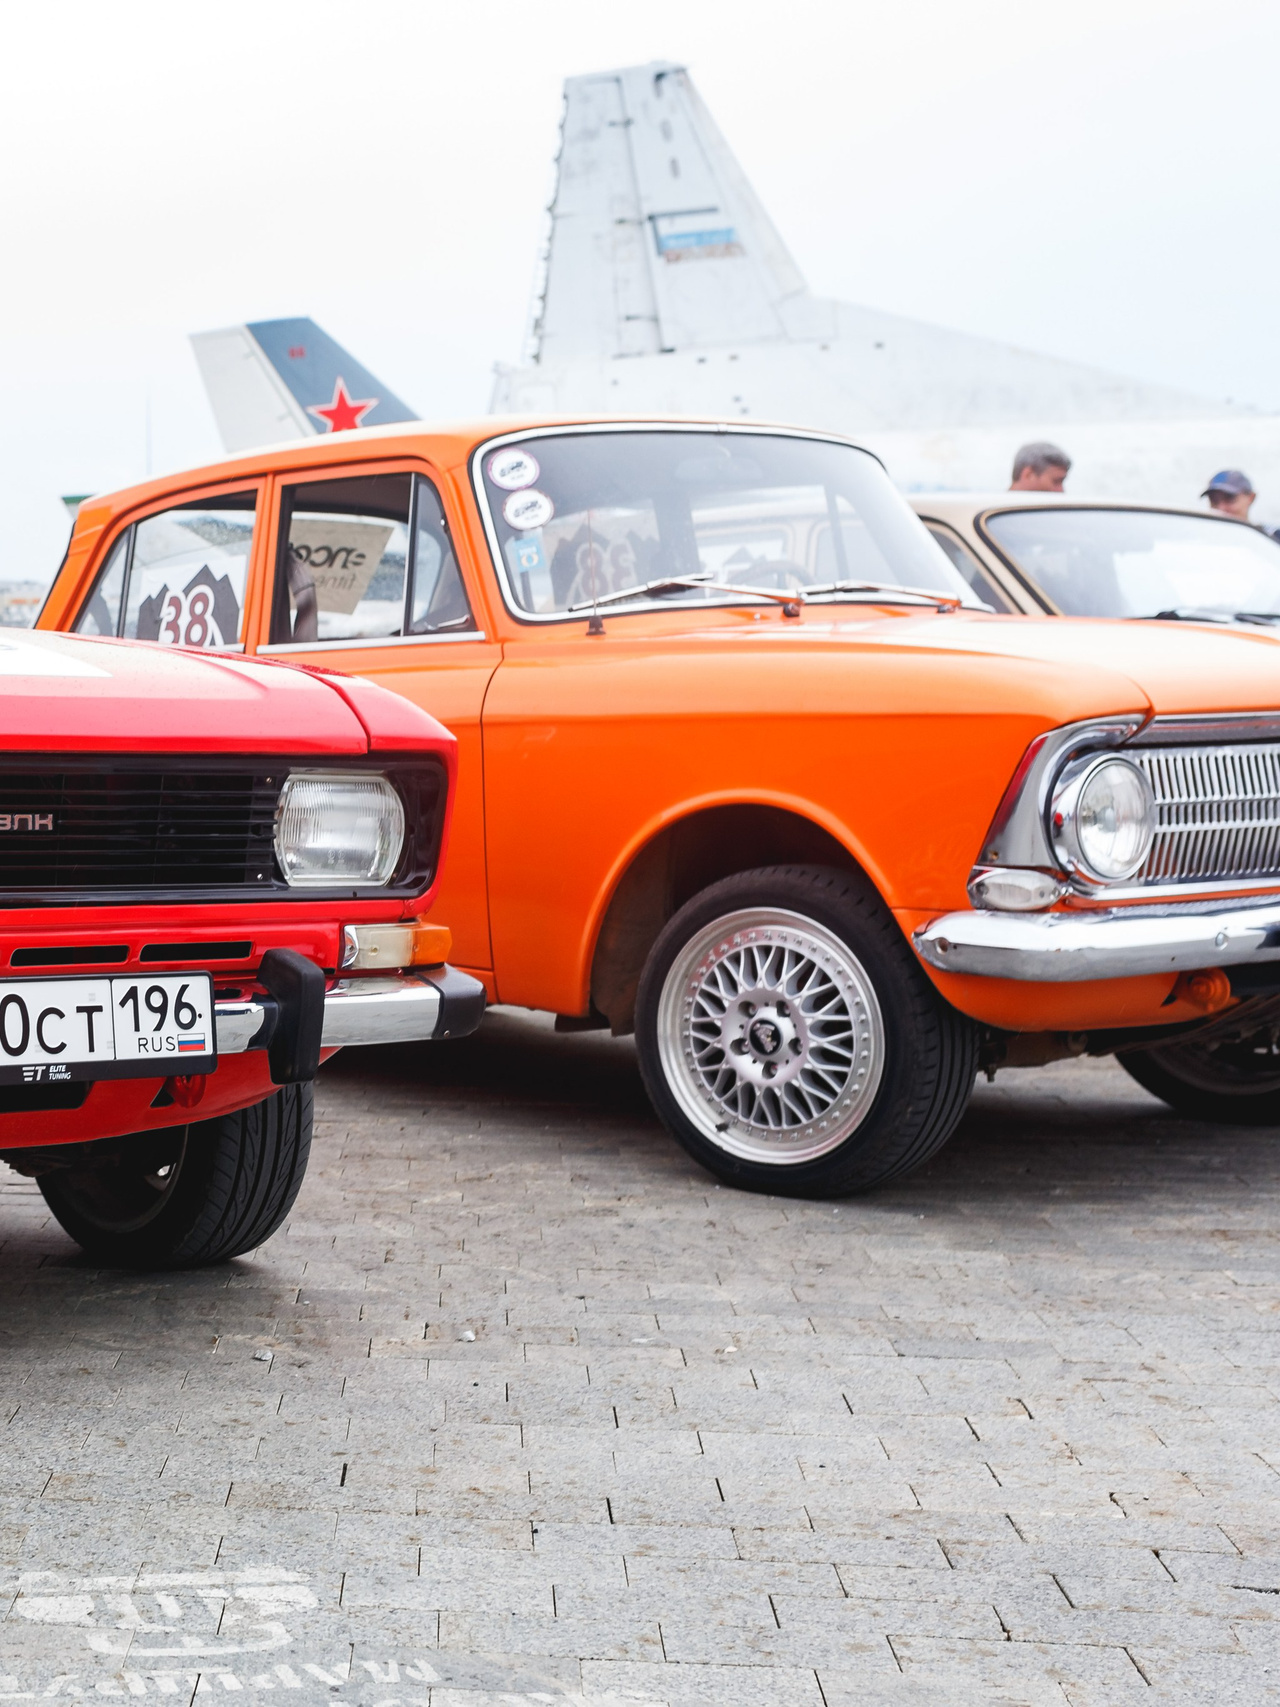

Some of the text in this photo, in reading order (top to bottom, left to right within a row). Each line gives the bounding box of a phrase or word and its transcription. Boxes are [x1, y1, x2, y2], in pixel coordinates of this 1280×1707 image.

[160, 586, 214, 646] 38
[118, 984, 198, 1033] 196
[137, 1036, 176, 1054] RUS
[48, 1071, 72, 1081] TUNING
[49, 1064, 67, 1073] ELITE
